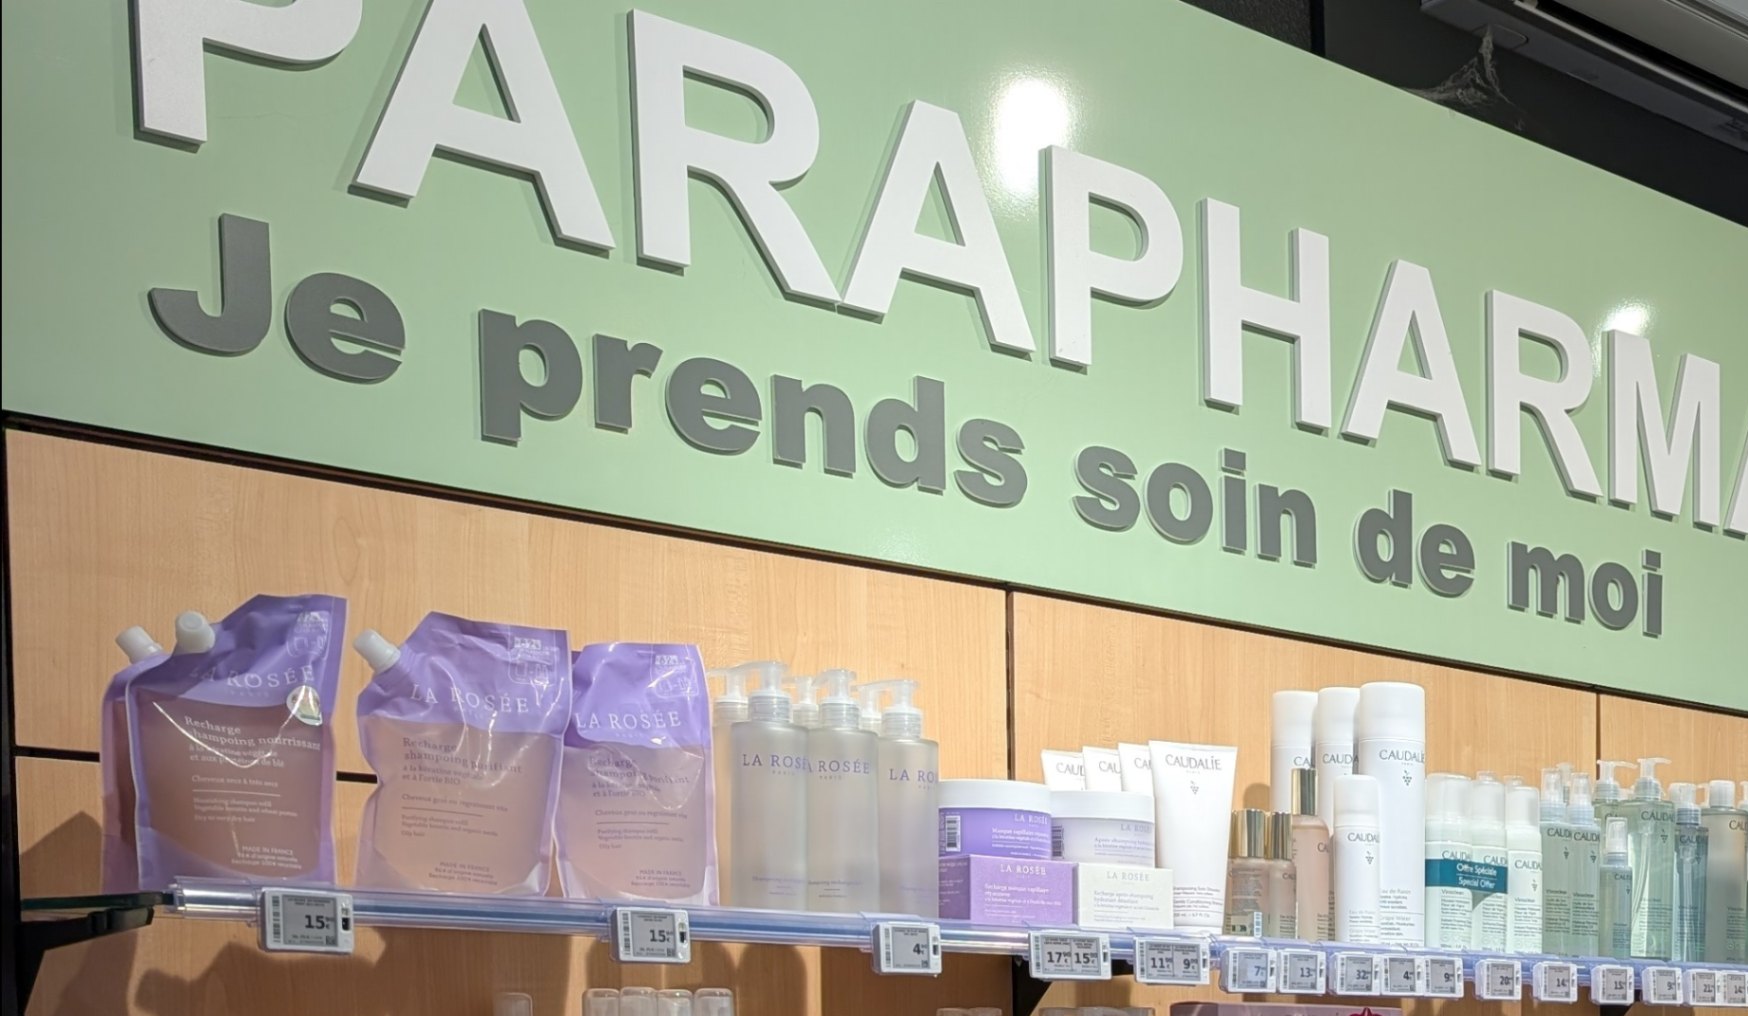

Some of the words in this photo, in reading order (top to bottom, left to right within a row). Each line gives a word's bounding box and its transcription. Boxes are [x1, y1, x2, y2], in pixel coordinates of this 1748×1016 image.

[148, 212, 405, 383] Je
[478, 307, 1028, 508] prends
[1072, 448, 1318, 568] soin
[1356, 488, 1476, 598] de
[1506, 549, 1664, 638] moi
[410, 684, 438, 704] LA
[451, 687, 529, 713] ROSÉE
[184, 716, 242, 735] Recharge
[575, 712, 600, 729] LA
[610, 710, 681, 729] ROSÉE
[819, 758, 870, 775] ROSÉE
[1001, 865, 1013, 873] LA
[1456, 863, 1473, 873] Offre
[1474, 865, 1498, 877] Spéciale
[1458, 877, 1476, 887] Special
[1478, 879, 1496, 889] Offer
[304, 914, 326, 930] 15
[649, 929, 667, 942] 15
